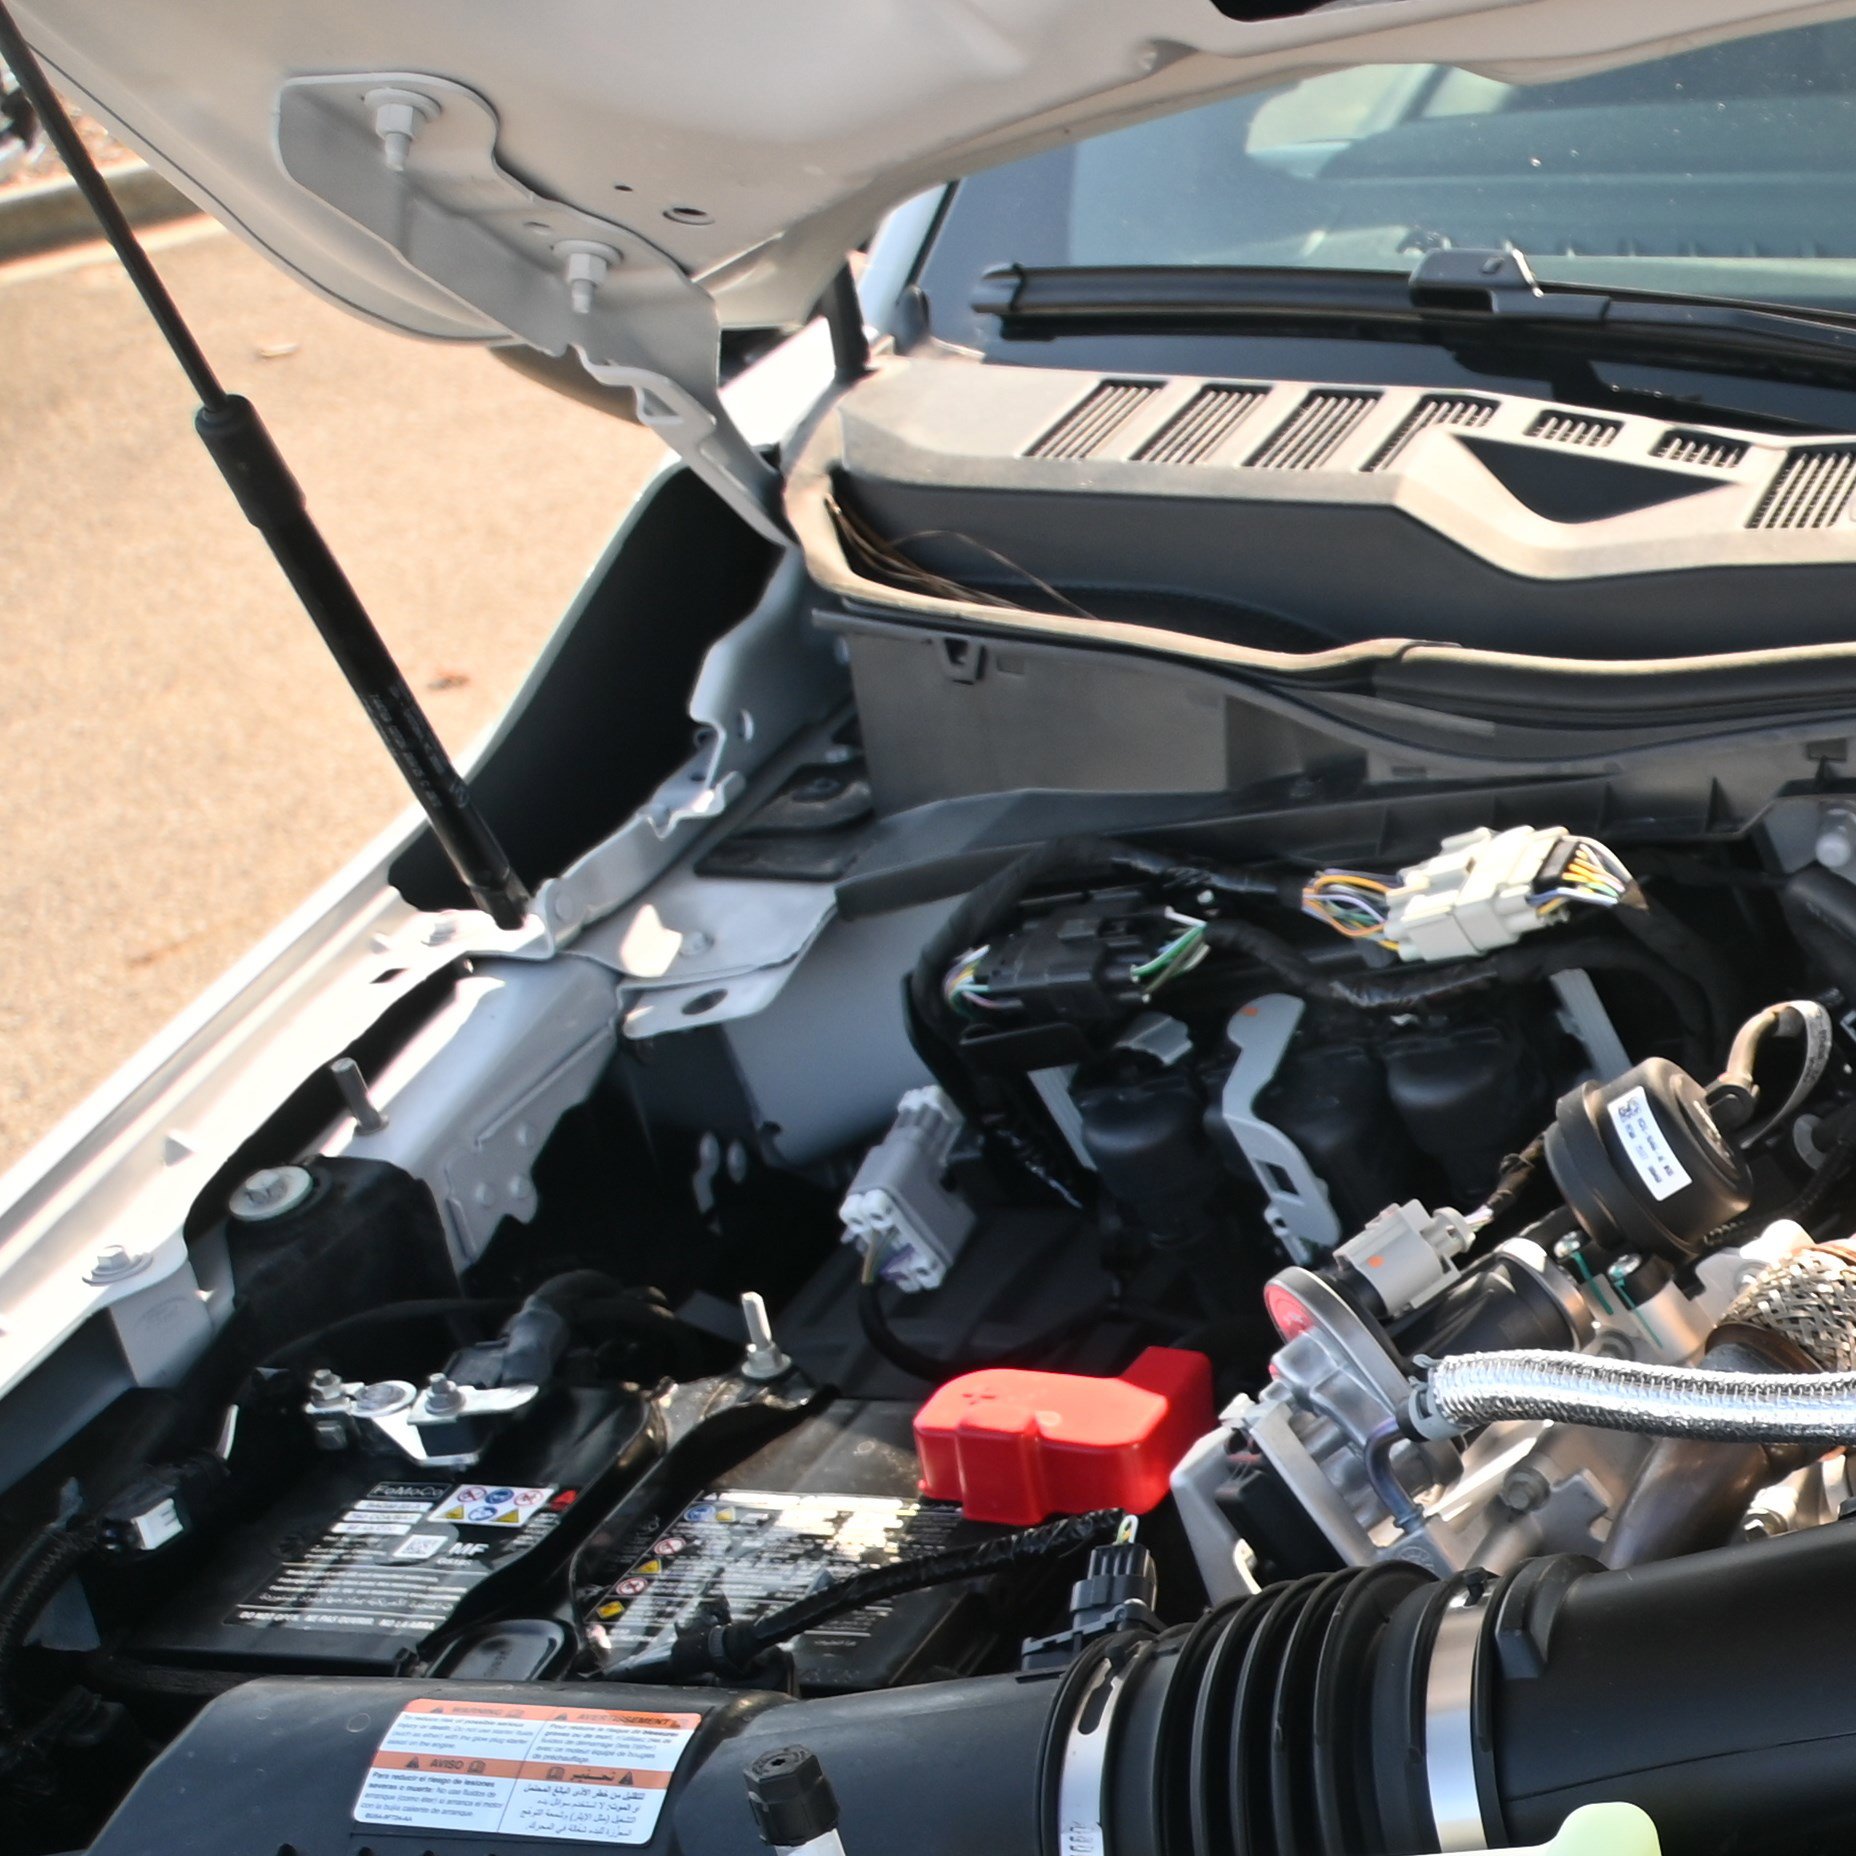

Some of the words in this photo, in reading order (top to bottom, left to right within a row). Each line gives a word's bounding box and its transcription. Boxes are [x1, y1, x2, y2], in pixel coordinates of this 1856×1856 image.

[371, 1485, 443, 1498] FoMoCo
[449, 1542, 489, 1556] MF
[430, 1759, 465, 1770] AVISO
